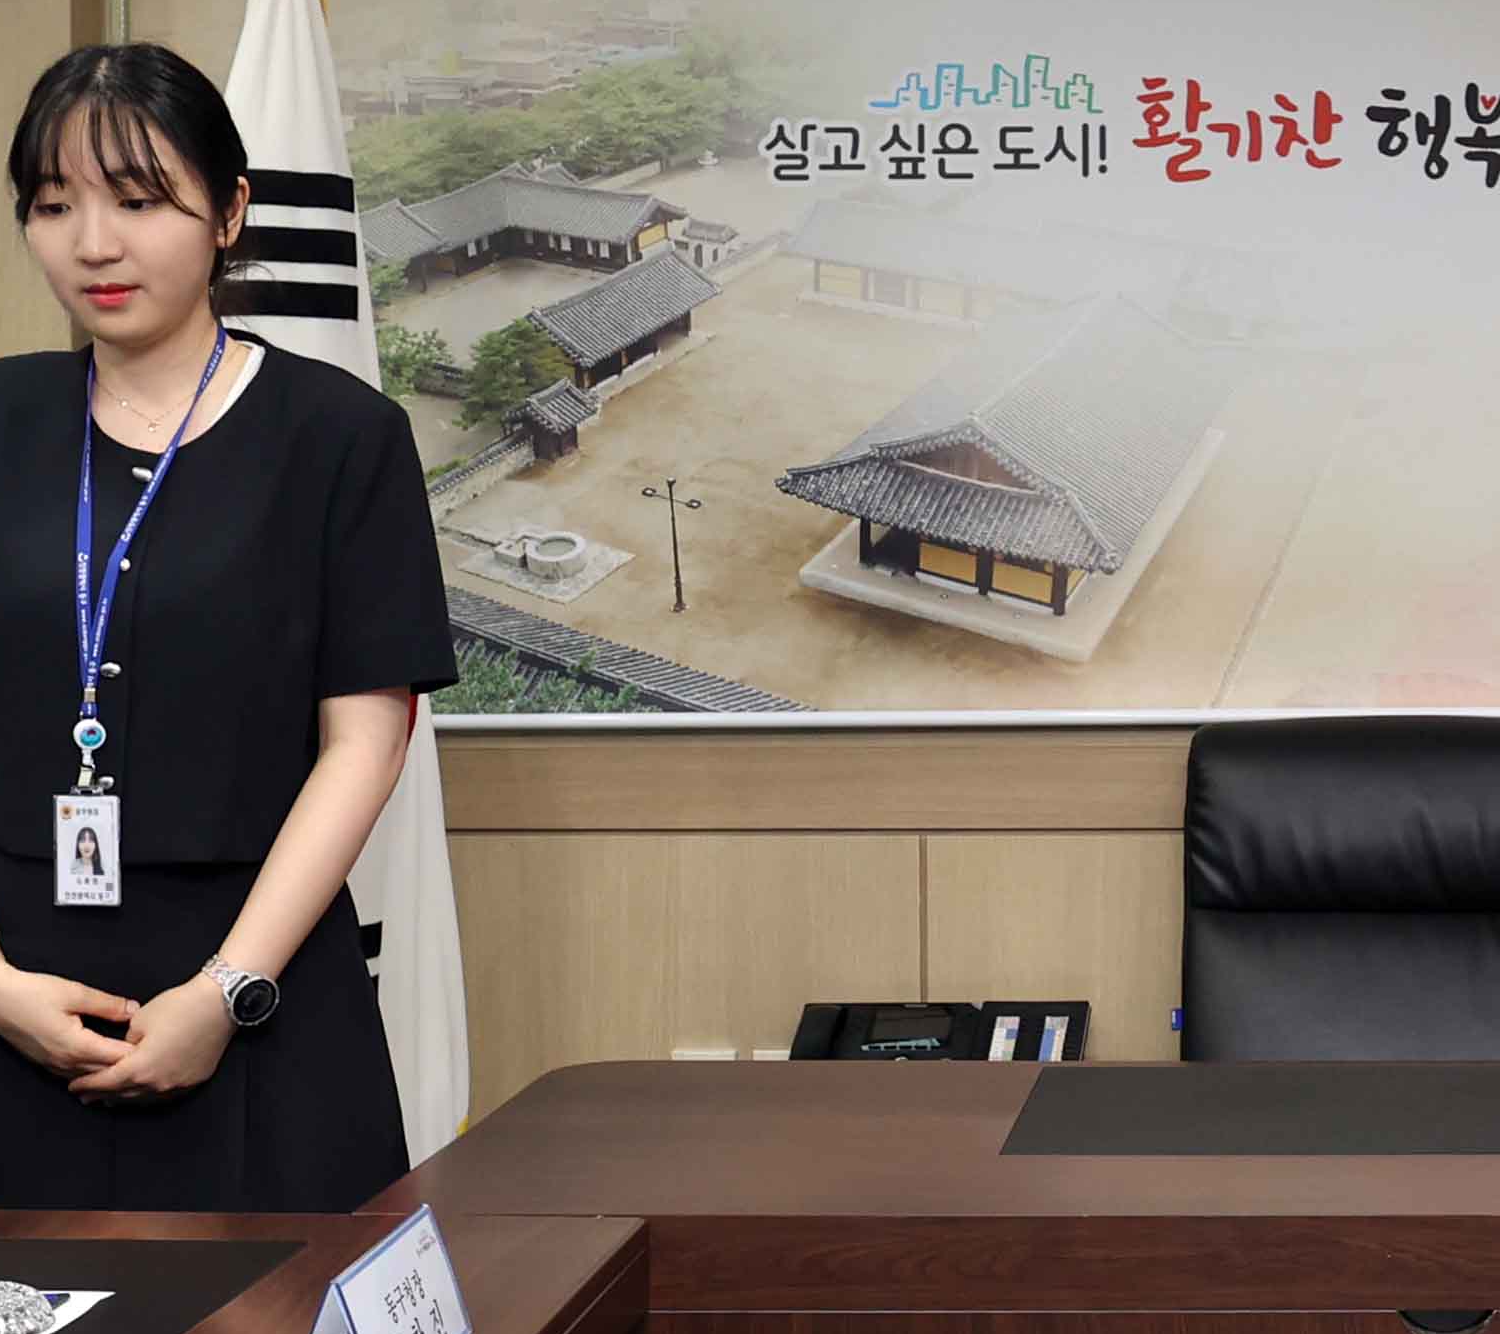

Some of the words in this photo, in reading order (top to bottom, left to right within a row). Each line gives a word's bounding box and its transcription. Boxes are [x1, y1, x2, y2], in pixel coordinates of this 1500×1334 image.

[764, 123, 867, 181] 살고
[879, 122, 980, 180] 싶은
[993, 122, 1109, 179] 도시!
[1132, 78, 1343, 182] 활기찬
[384, 1269, 425, 1324] 동구청장
